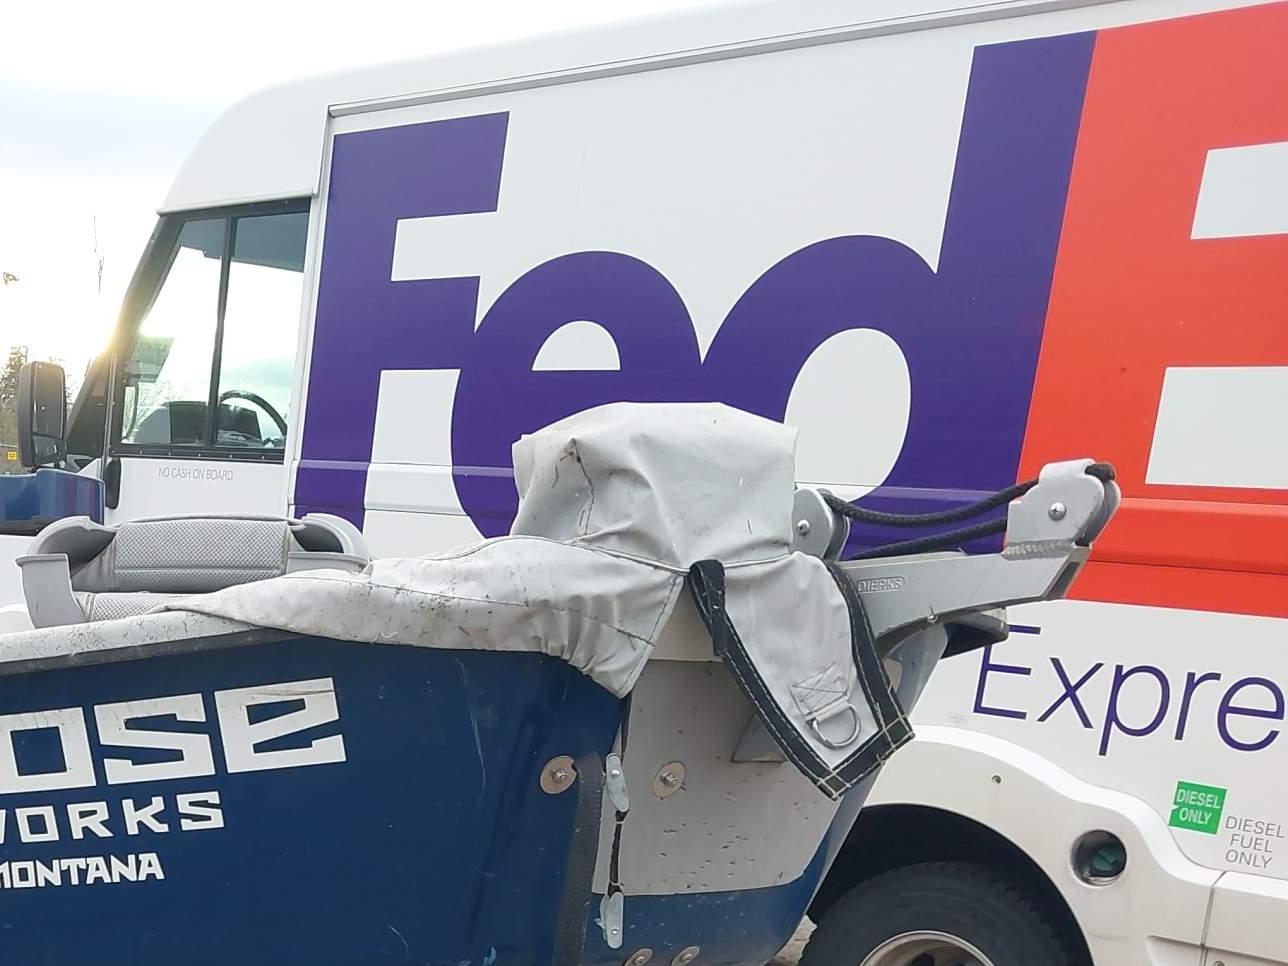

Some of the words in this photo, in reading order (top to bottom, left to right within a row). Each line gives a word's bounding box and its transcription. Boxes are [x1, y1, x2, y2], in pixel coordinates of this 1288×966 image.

[171, 466, 191, 479] CASH
[193, 468, 204, 480] ON
[206, 469, 234, 481] BOARD
[973, 624, 1286, 758] Expre
[1176, 788, 1221, 809] DIESEL
[1179, 807, 1213, 825] ONLY
[1225, 815, 1286, 839] DIESEL
[1230, 833, 1273, 854] FUEL
[1225, 849, 1273, 869] ONLY
